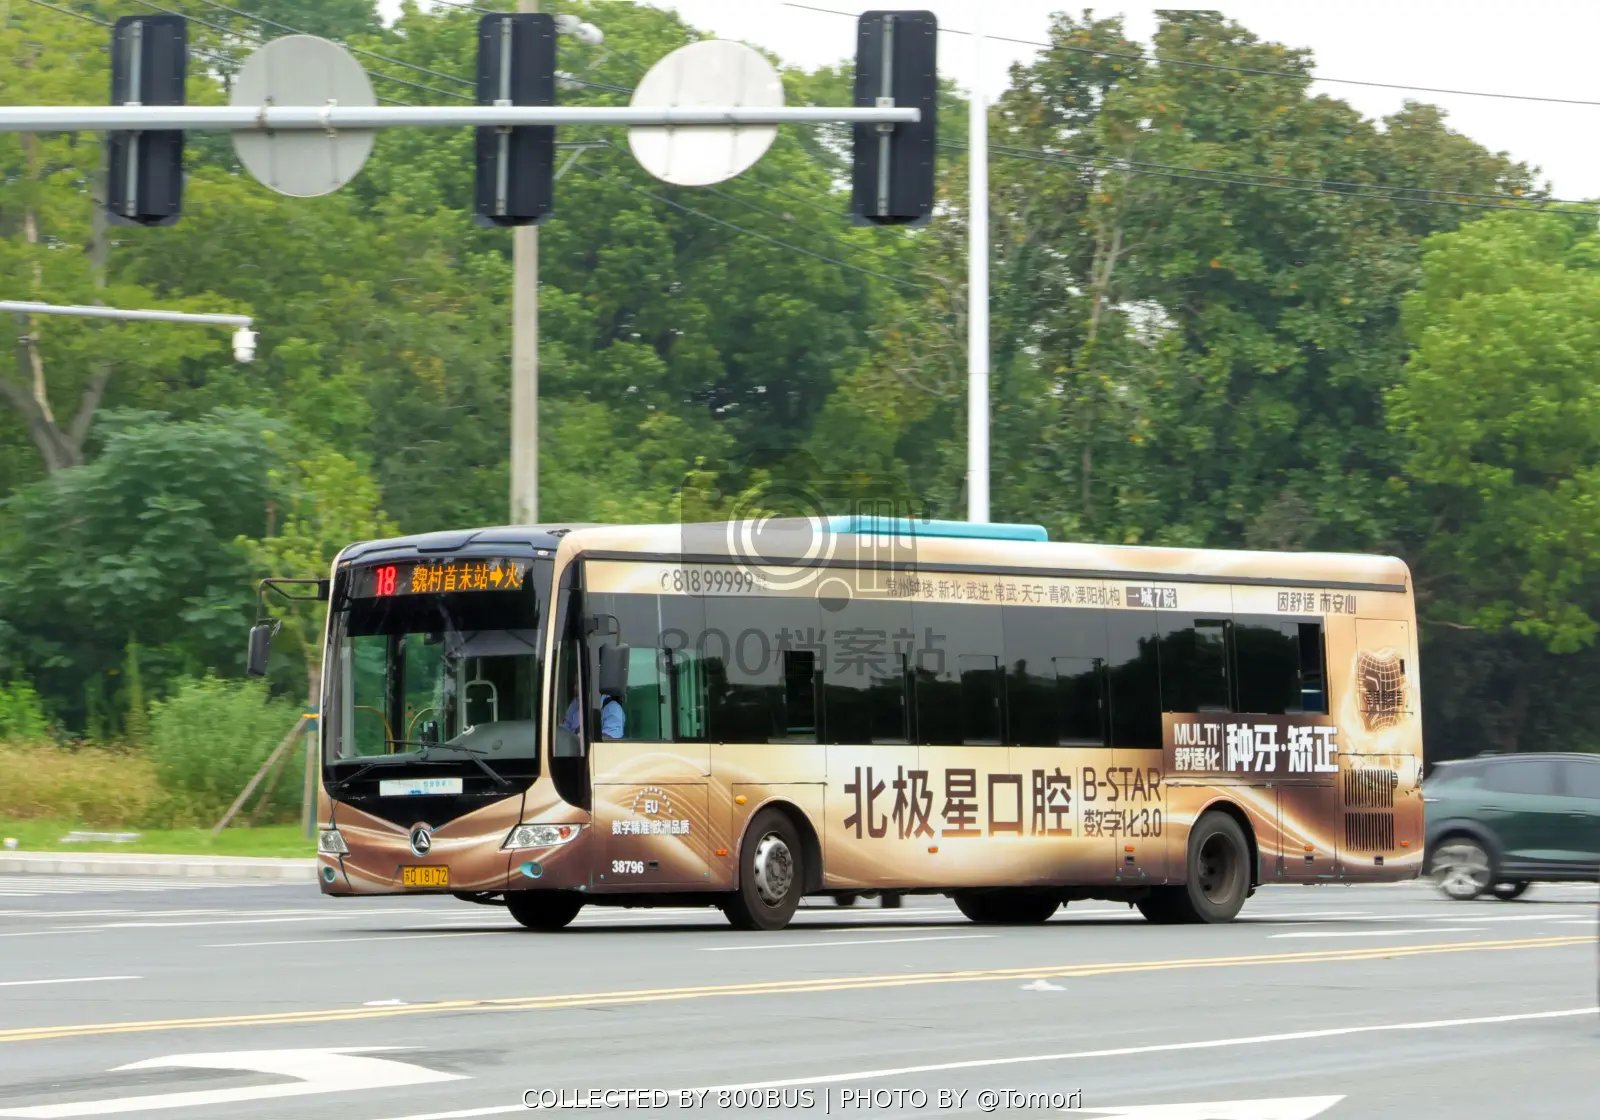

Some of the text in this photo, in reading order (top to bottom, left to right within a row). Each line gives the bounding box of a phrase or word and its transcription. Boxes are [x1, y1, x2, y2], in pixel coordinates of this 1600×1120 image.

[376, 566, 397, 596] 18
[411, 563, 488, 593] 魏村首末站
[1277, 591, 1356, 615] 因舒适 而安心
[1175, 747, 1220, 771] 舒适化
[1226, 724, 1339, 773] 种牙·矫正
[1083, 766, 1162, 802] B-STAR
[645, 800, 658, 813] EU
[843, 765, 1073, 840] 北极星口腔
[1083, 808, 1162, 838] 数字化3.0
[612, 860, 645, 874] 38796
